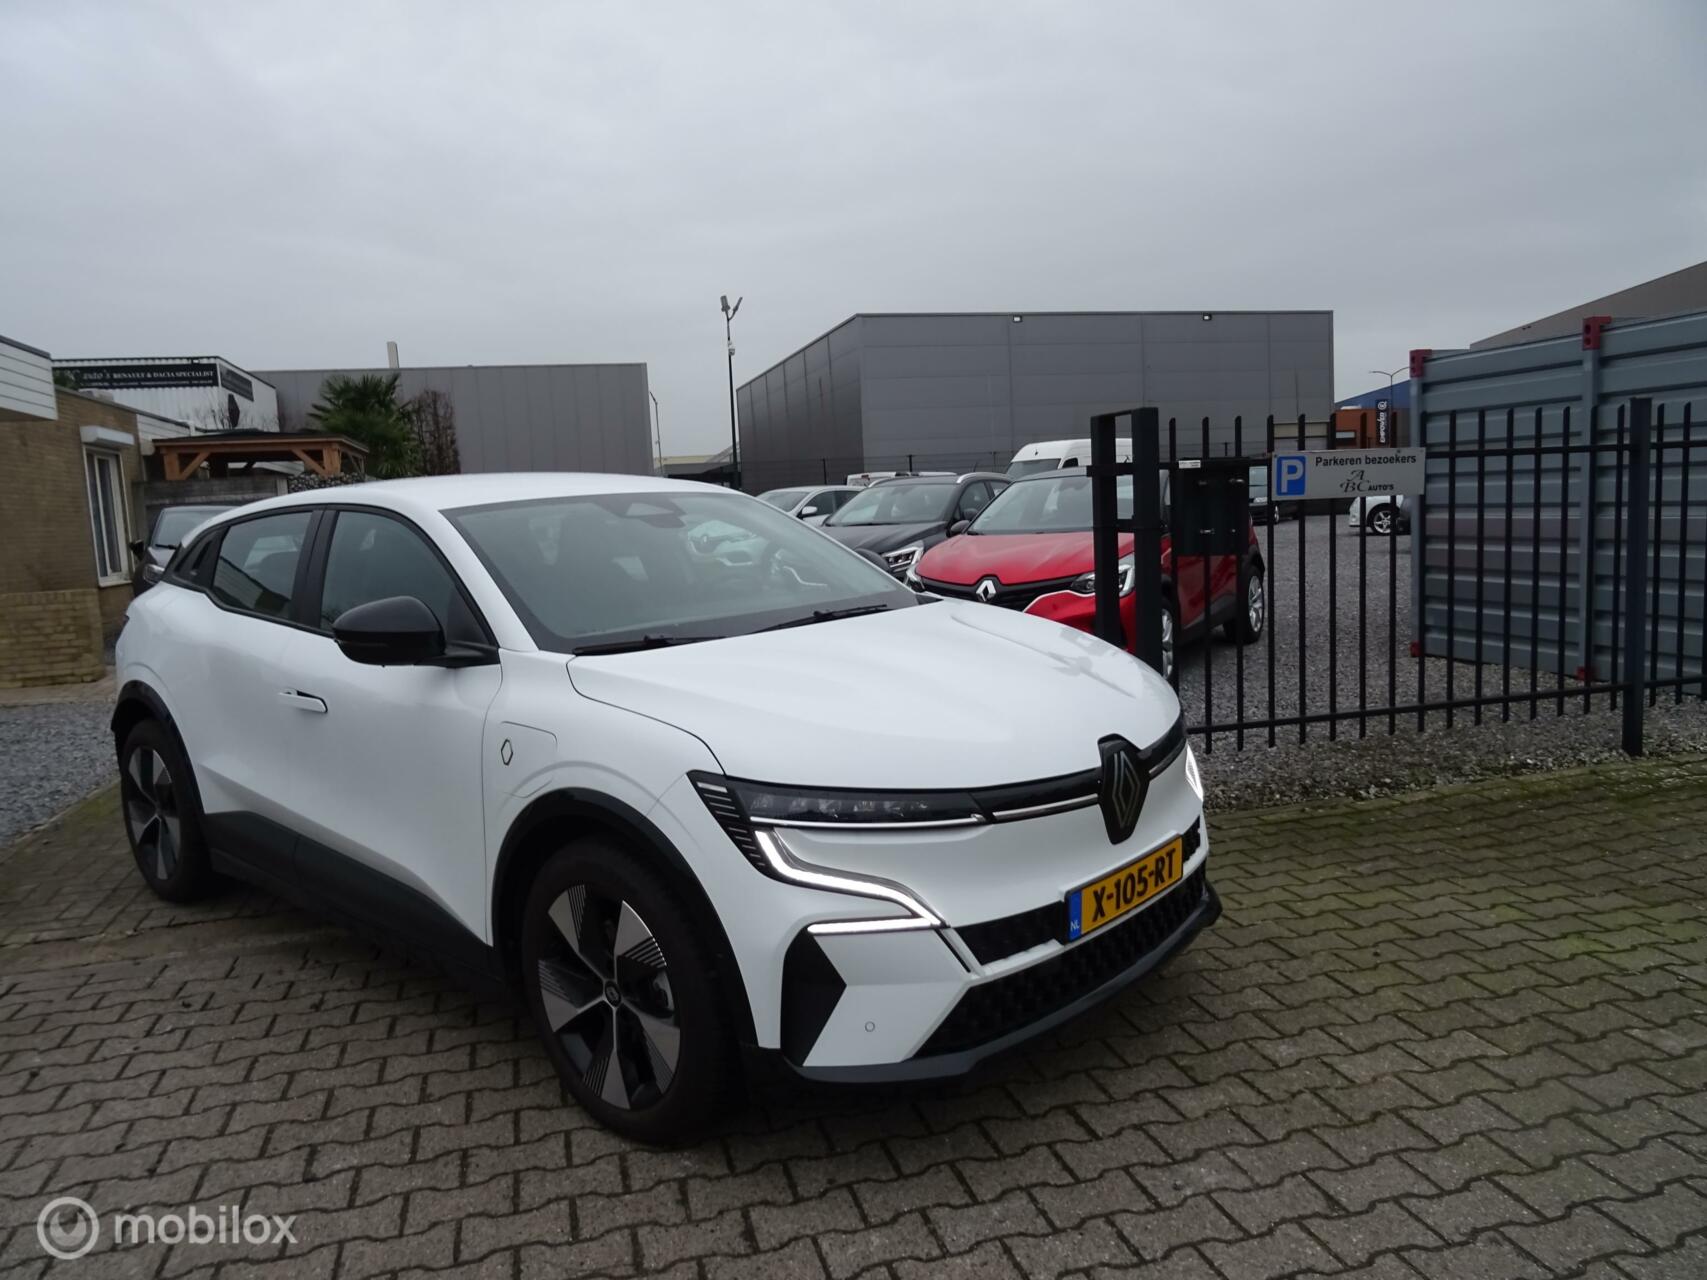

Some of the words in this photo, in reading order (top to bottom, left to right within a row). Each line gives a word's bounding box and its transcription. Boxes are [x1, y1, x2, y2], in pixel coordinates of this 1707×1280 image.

[175, 370, 214, 378] SPECIALIST
[1315, 456, 1362, 467] Parkeren
[1364, 454, 1417, 465] bezoekers
[1281, 459, 1304, 493] P
[1092, 848, 1176, 922] X-105-RT
[1070, 919, 1080, 932] NL
